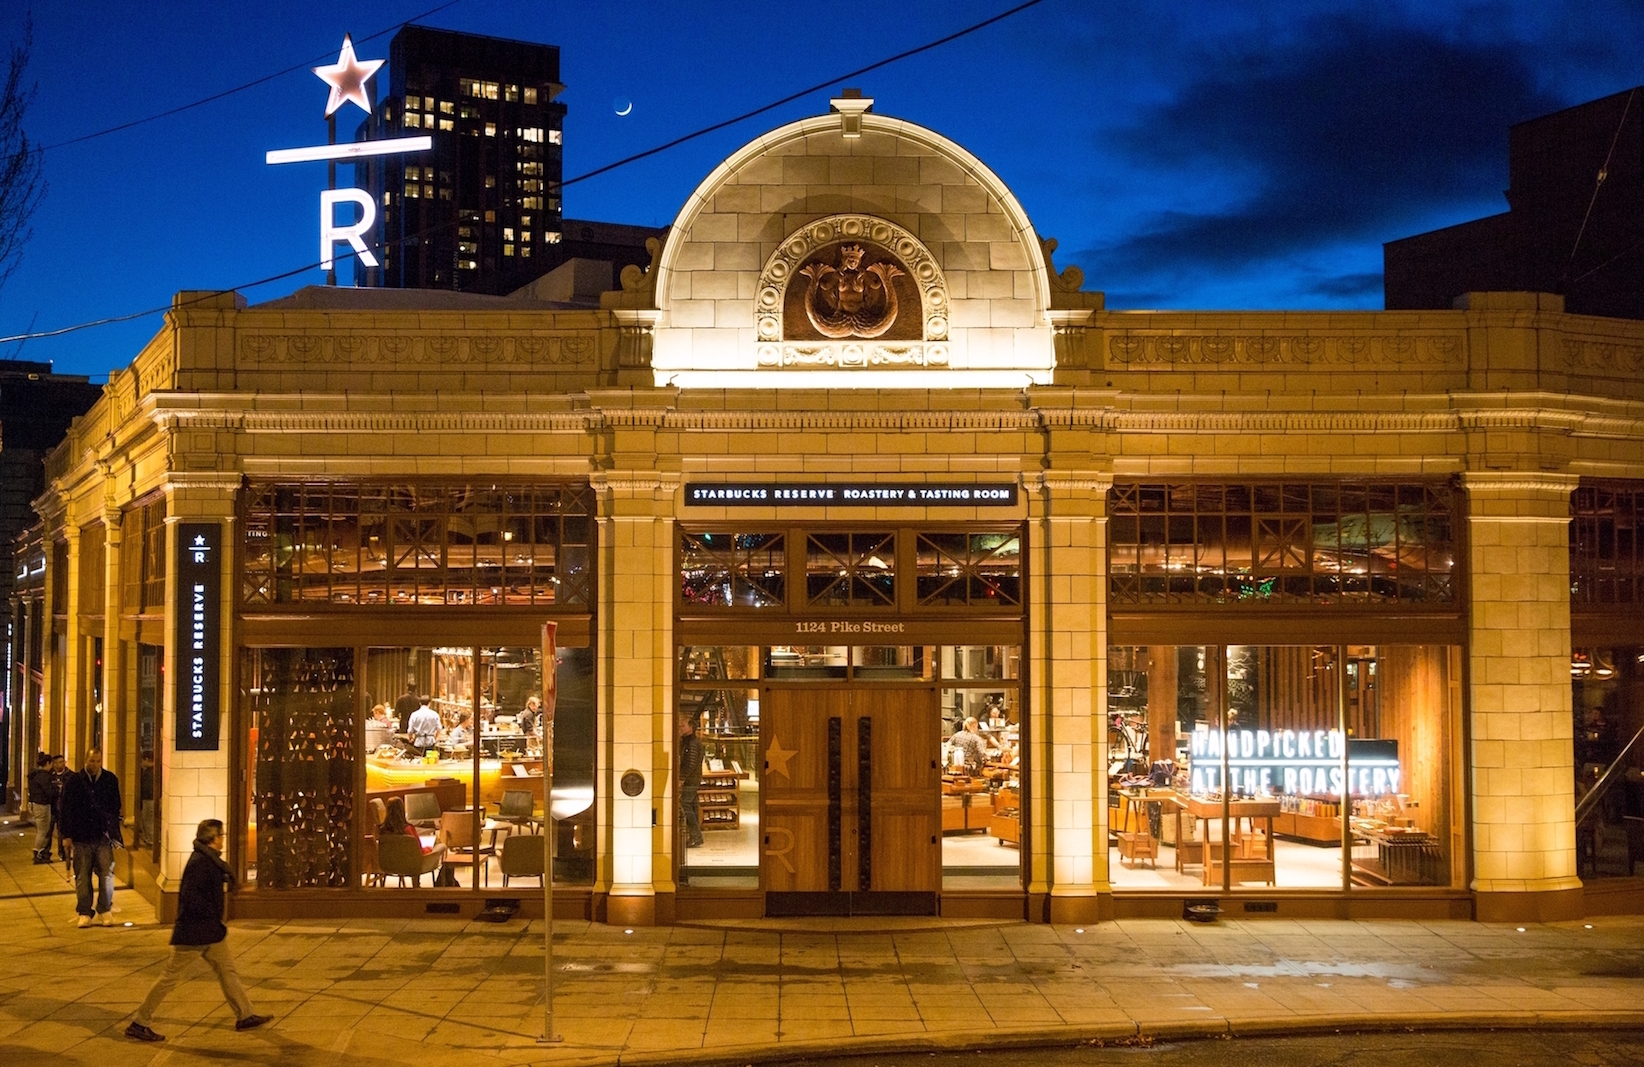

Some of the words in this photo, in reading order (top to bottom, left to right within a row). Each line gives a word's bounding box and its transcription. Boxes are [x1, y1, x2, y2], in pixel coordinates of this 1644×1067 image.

[320, 187, 379, 270] R
[693, 489, 767, 499] STARBUCKS
[774, 489, 833, 499] RESERVE
[843, 489, 904, 499] ROASTERY
[908, 489, 917, 499] &
[920, 489, 970, 499] TASTING
[973, 489, 1010, 499] ROOM
[194, 551, 205, 563] R
[193, 584, 205, 650] RESERVE
[796, 622, 826, 633] 1124
[830, 621, 861, 633] Pike
[862, 621, 905, 633] Street
[192, 657, 204, 738] STARBUCKS
[1191, 729, 1344, 758] HANDPICKED
[1192, 767, 1217, 794] AT
[1230, 767, 1271, 795] THE
[1284, 767, 1400, 795] ROASTERY
